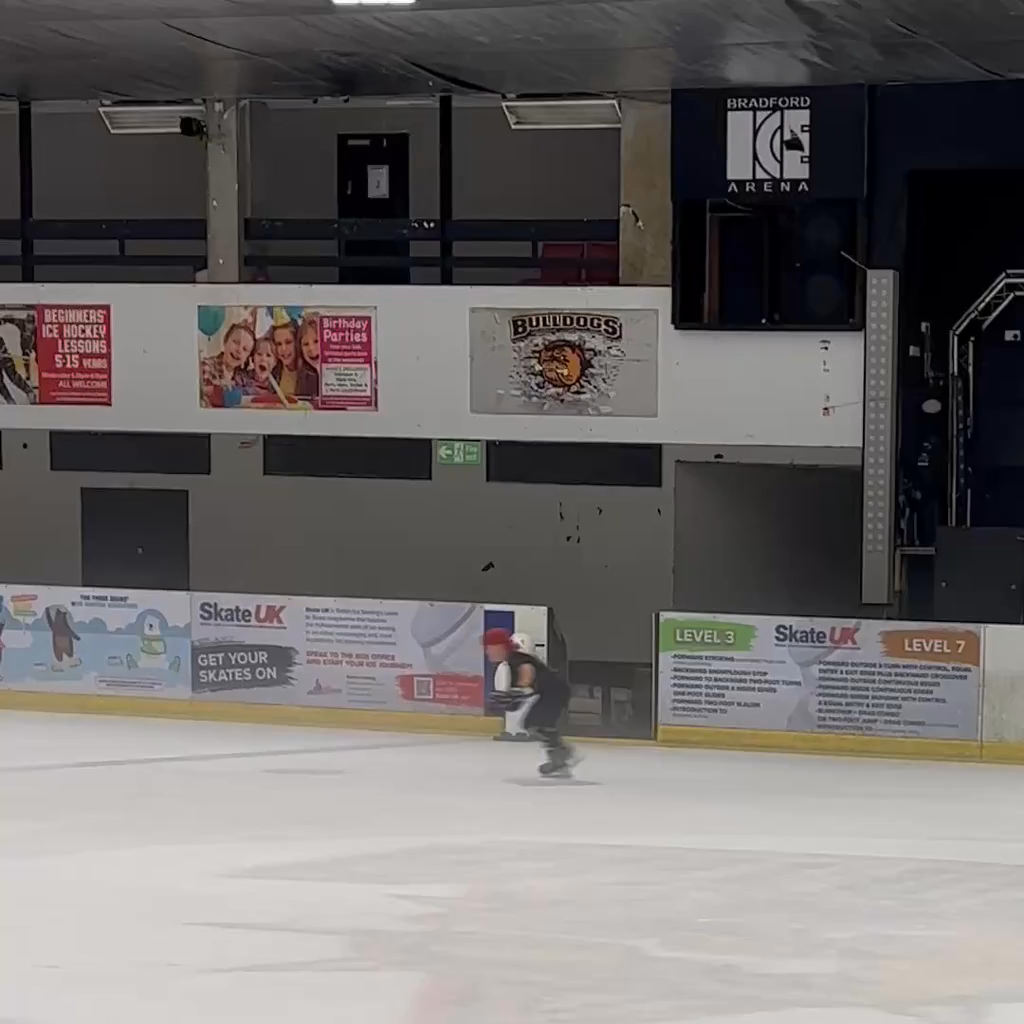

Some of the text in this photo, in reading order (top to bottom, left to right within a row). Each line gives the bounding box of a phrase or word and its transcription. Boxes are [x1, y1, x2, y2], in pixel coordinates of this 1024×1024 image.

[727, 96, 811, 109] BRADFORD
[726, 109, 811, 180] ICE
[727, 181, 809, 193] ARENA
[42, 324, 106, 339] ICE HOCKEY
[323, 318, 368, 331] Birthday
[509, 312, 623, 341] BULLDOGS
[323, 329, 368, 342] Parties
[58, 339, 107, 353] LESSONS
[199, 602, 252, 623] Skate
[254, 604, 287, 625] UK
[674, 628, 735, 644] LEVEL 3
[774, 624, 860, 646] Skate UK
[904, 638, 966, 653] LEVEL 7
[198, 651, 268, 666] GET YOUR
[199, 666, 277, 683] SKATES ON
